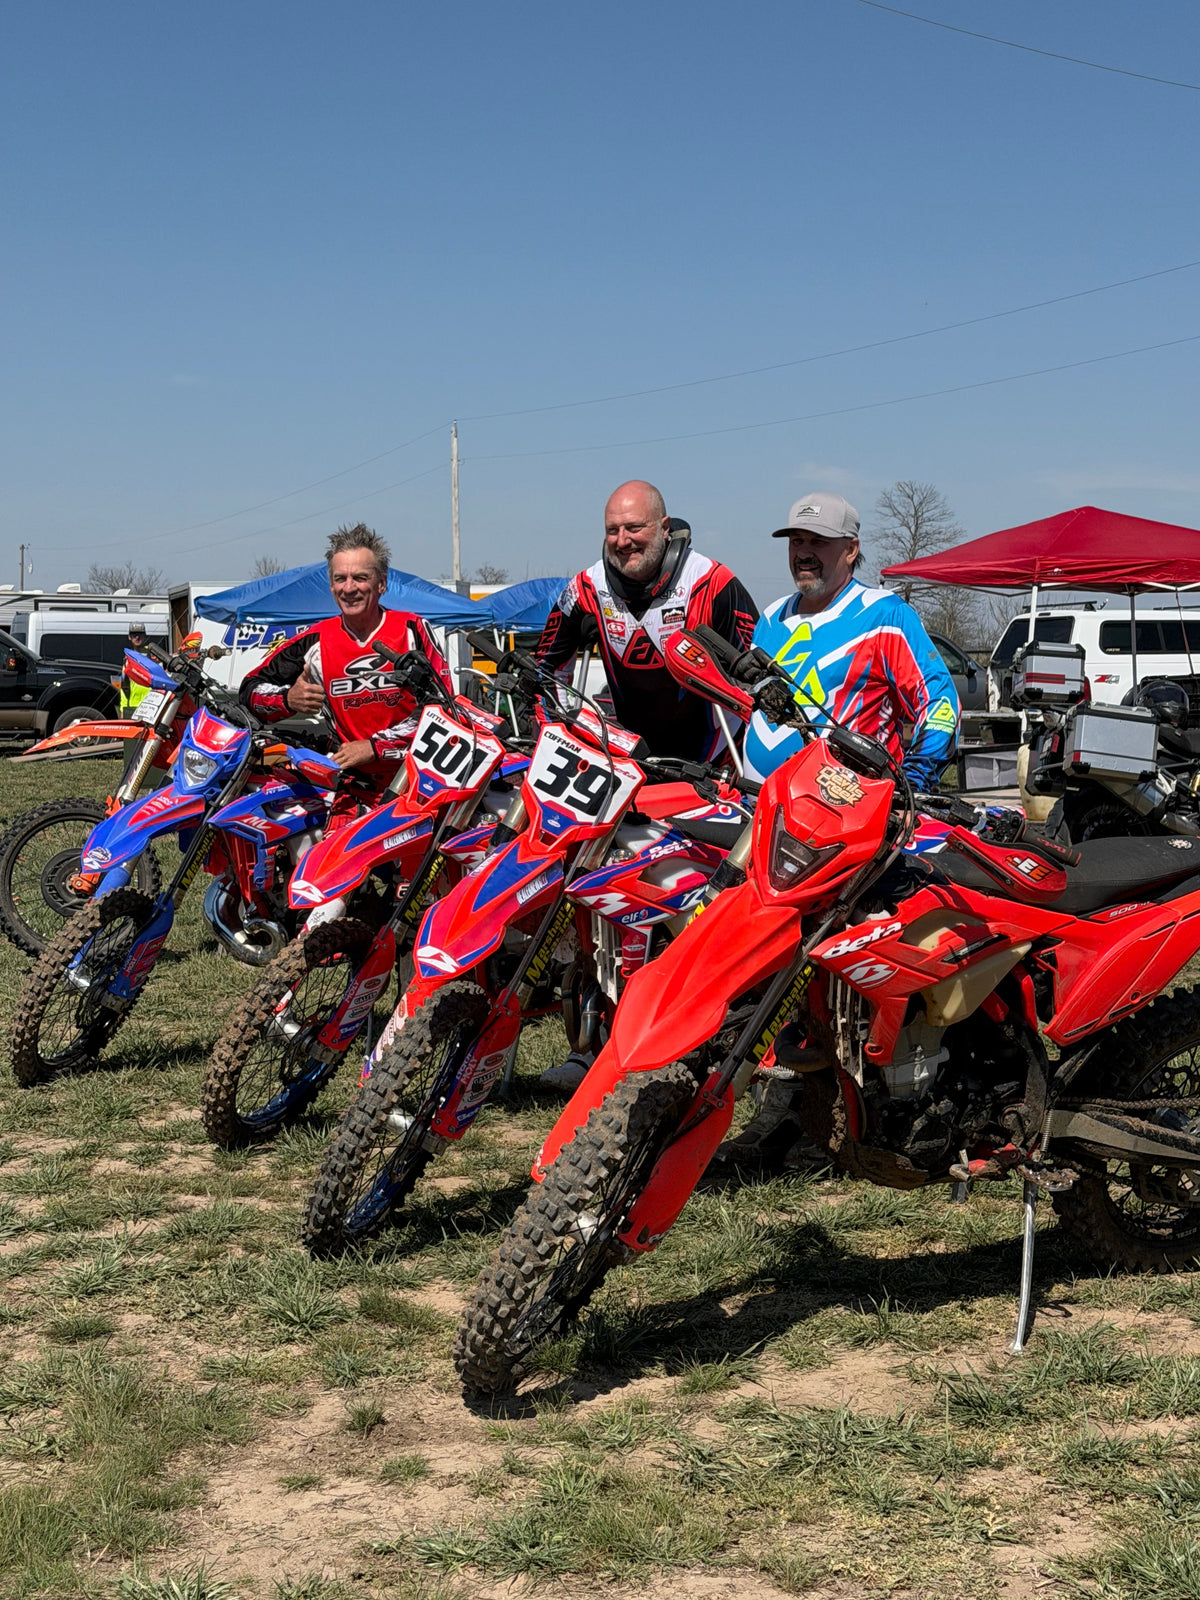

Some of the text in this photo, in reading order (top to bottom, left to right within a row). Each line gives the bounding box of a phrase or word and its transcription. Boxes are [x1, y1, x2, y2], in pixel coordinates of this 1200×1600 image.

[342, 691, 404, 711] Racing
[426, 711, 447, 726] LITTLE
[412, 721, 489, 784] 501
[543, 730, 582, 754] COFFMAN
[533, 746, 622, 817] 39
[648, 839, 694, 861] Beta
[621, 912, 641, 924] elf
[526, 902, 571, 985] Marshall's
[821, 921, 903, 960] Beta
[753, 965, 813, 1061] Marshall's
